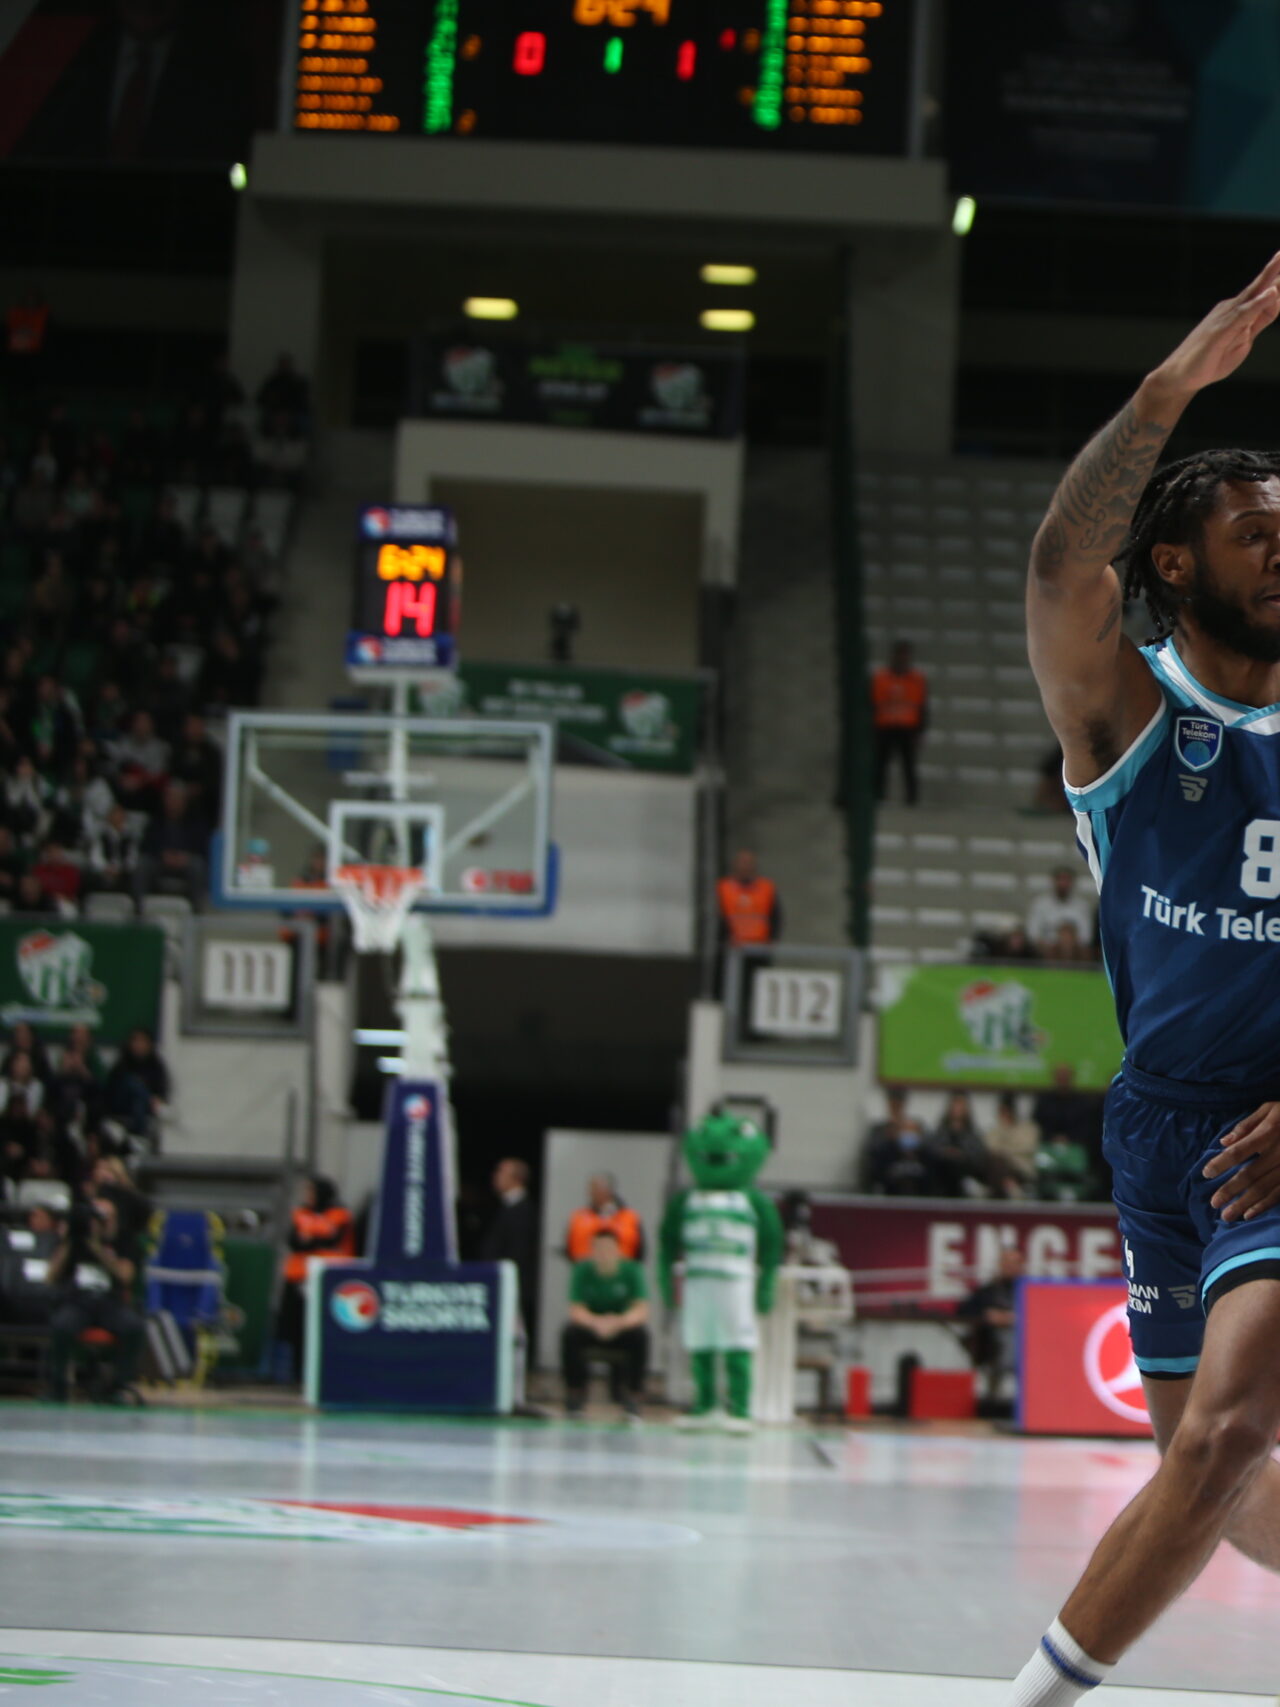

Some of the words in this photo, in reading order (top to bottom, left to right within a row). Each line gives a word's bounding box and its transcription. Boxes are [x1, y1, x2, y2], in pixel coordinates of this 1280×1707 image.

[383, 581, 437, 638] 14
[1141, 884, 1207, 936] Türk
[223, 950, 275, 995] 111
[765, 976, 831, 1025] 112
